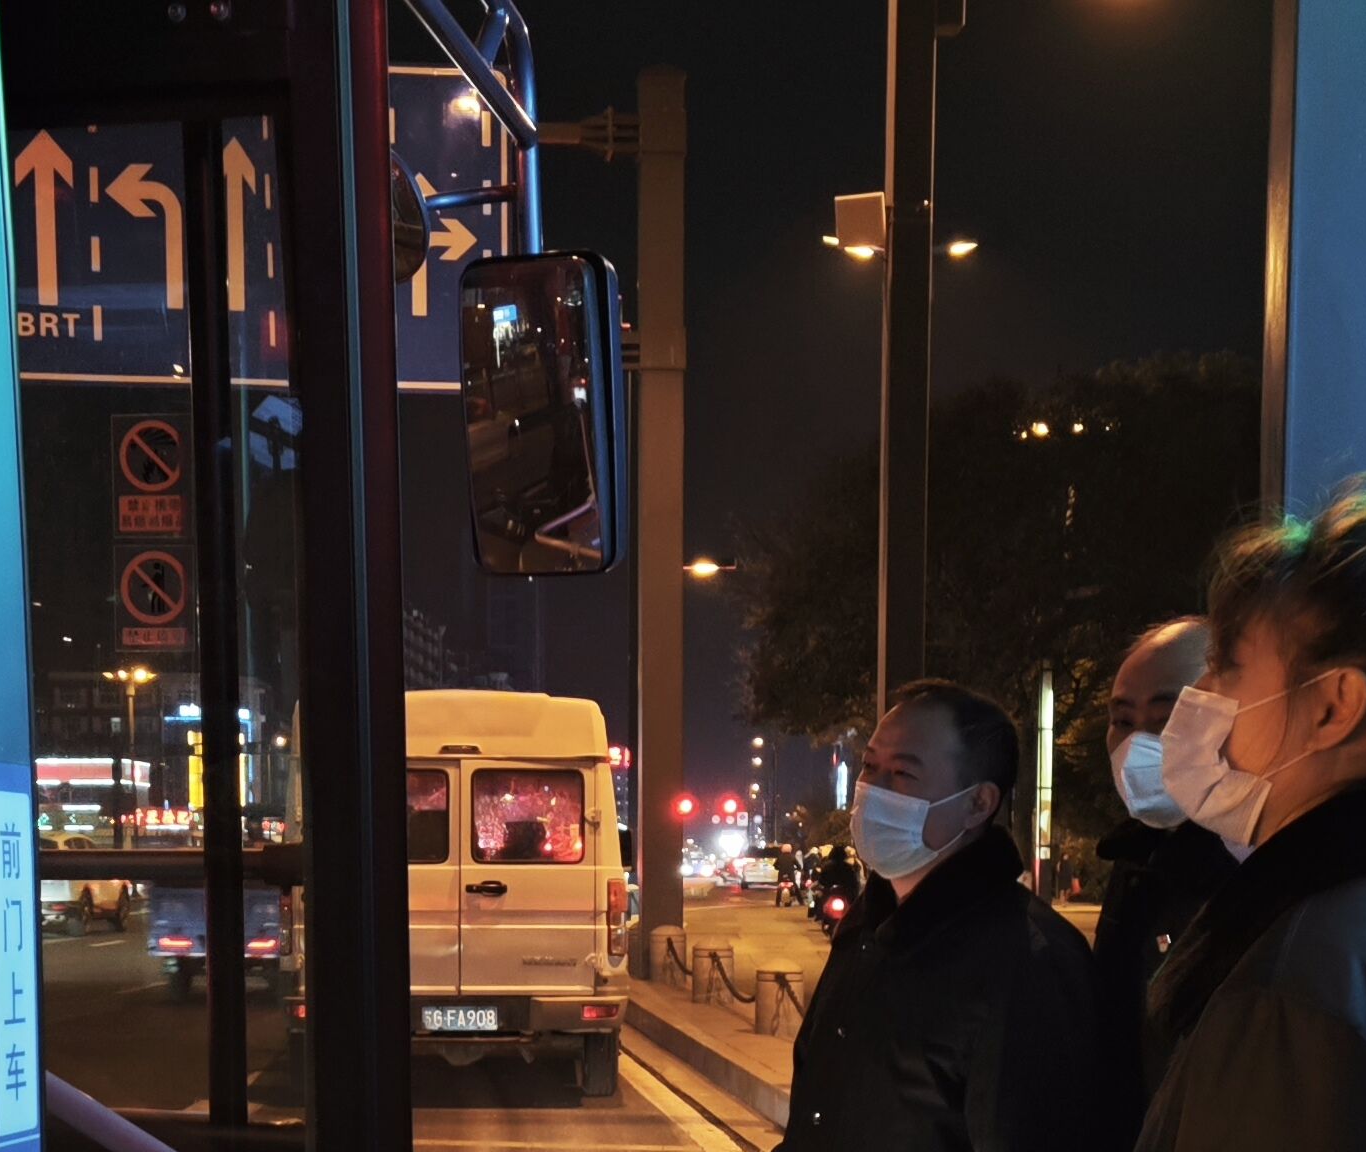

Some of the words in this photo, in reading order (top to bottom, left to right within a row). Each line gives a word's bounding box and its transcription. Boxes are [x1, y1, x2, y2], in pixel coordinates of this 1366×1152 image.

[17, 312, 80, 337] BRT
[0, 821, 28, 1102] 前门上车
